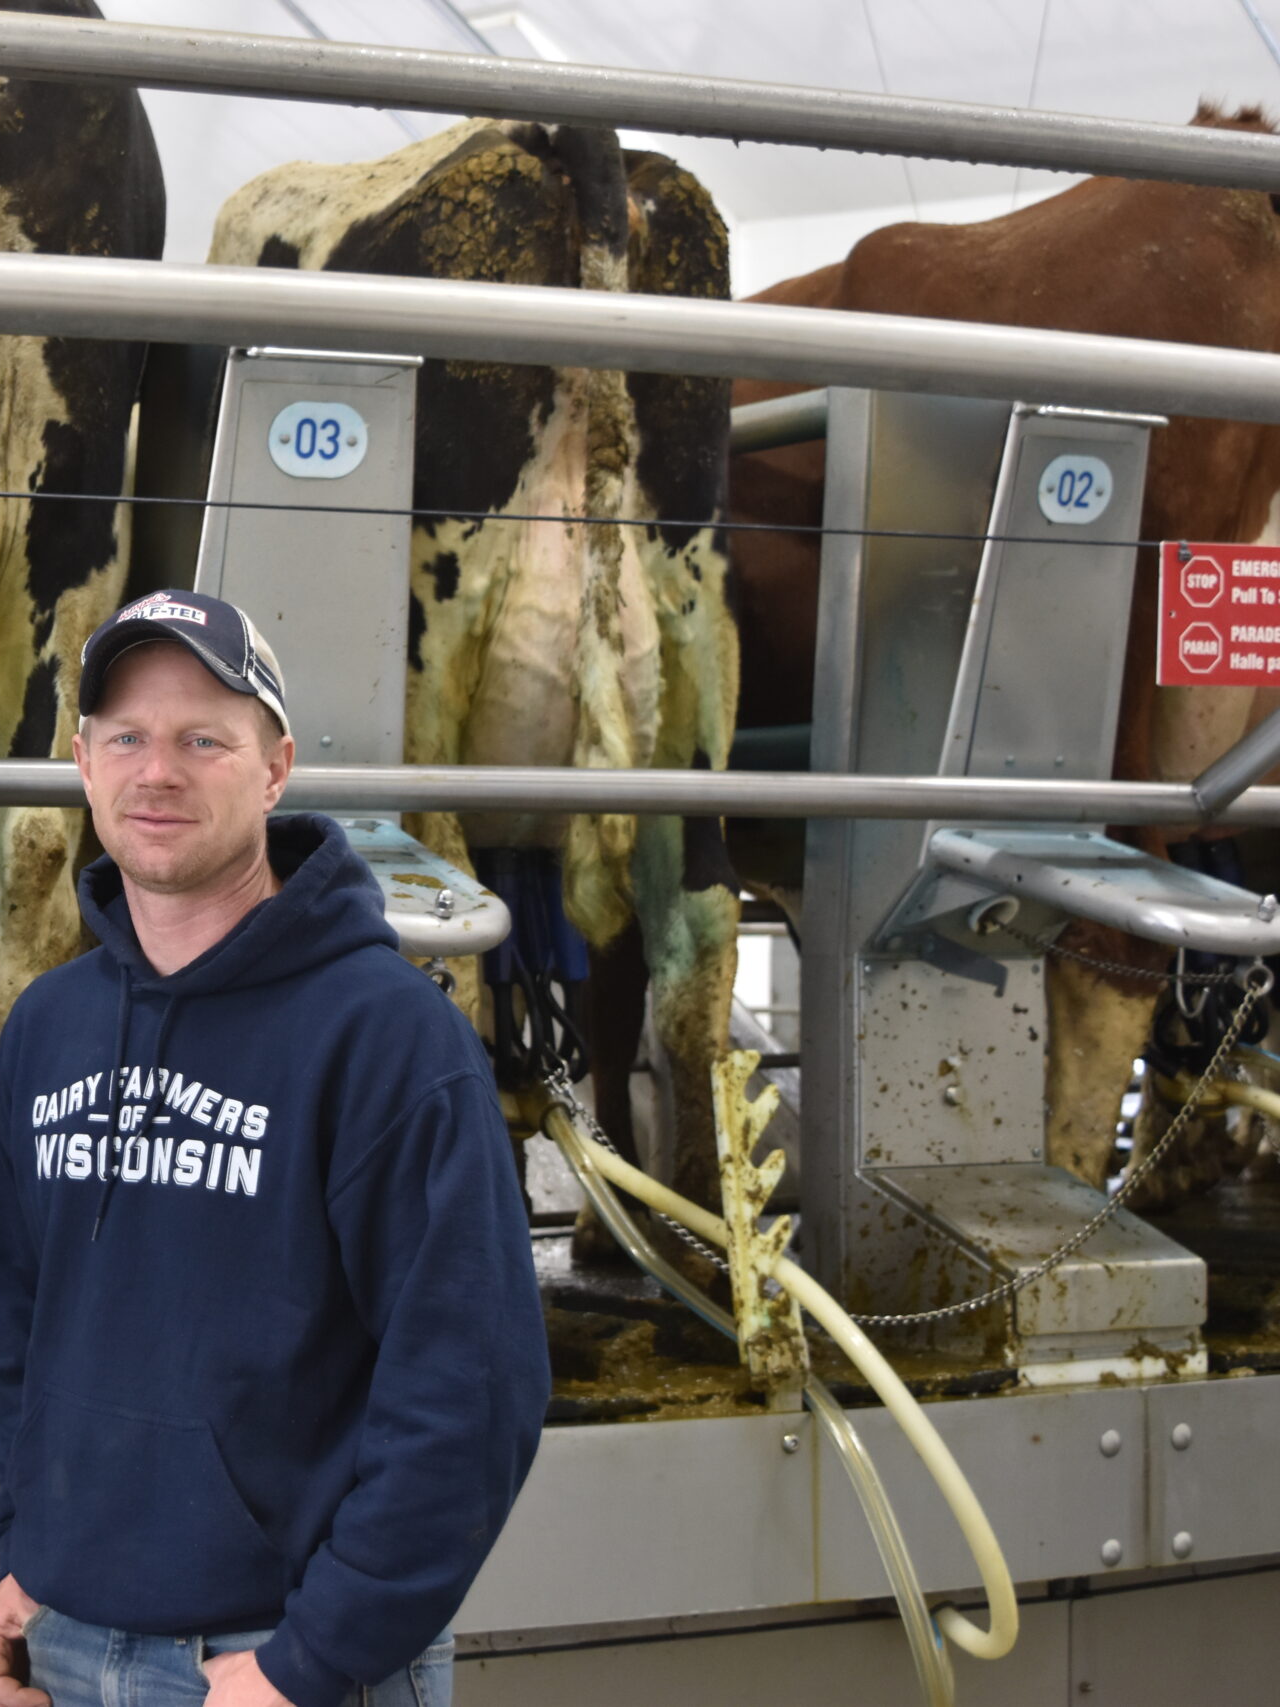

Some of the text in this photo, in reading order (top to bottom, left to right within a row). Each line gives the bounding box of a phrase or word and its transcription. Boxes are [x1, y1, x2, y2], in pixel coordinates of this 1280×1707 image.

[295, 417, 341, 460] 03
[1057, 469, 1094, 508] 02
[1232, 560, 1280, 578] EMERG
[1187, 573, 1218, 589] STOP
[1231, 586, 1258, 604] Pull
[1260, 587, 1276, 605] To
[128, 606, 201, 621] ALF-TEL
[1183, 640, 1218, 656] PARAR
[1230, 653, 1264, 670] Halle
[32, 1071, 103, 1128] DAIRY
[119, 1104, 147, 1132] OF
[34, 1133, 262, 1197] WISCONSIN
